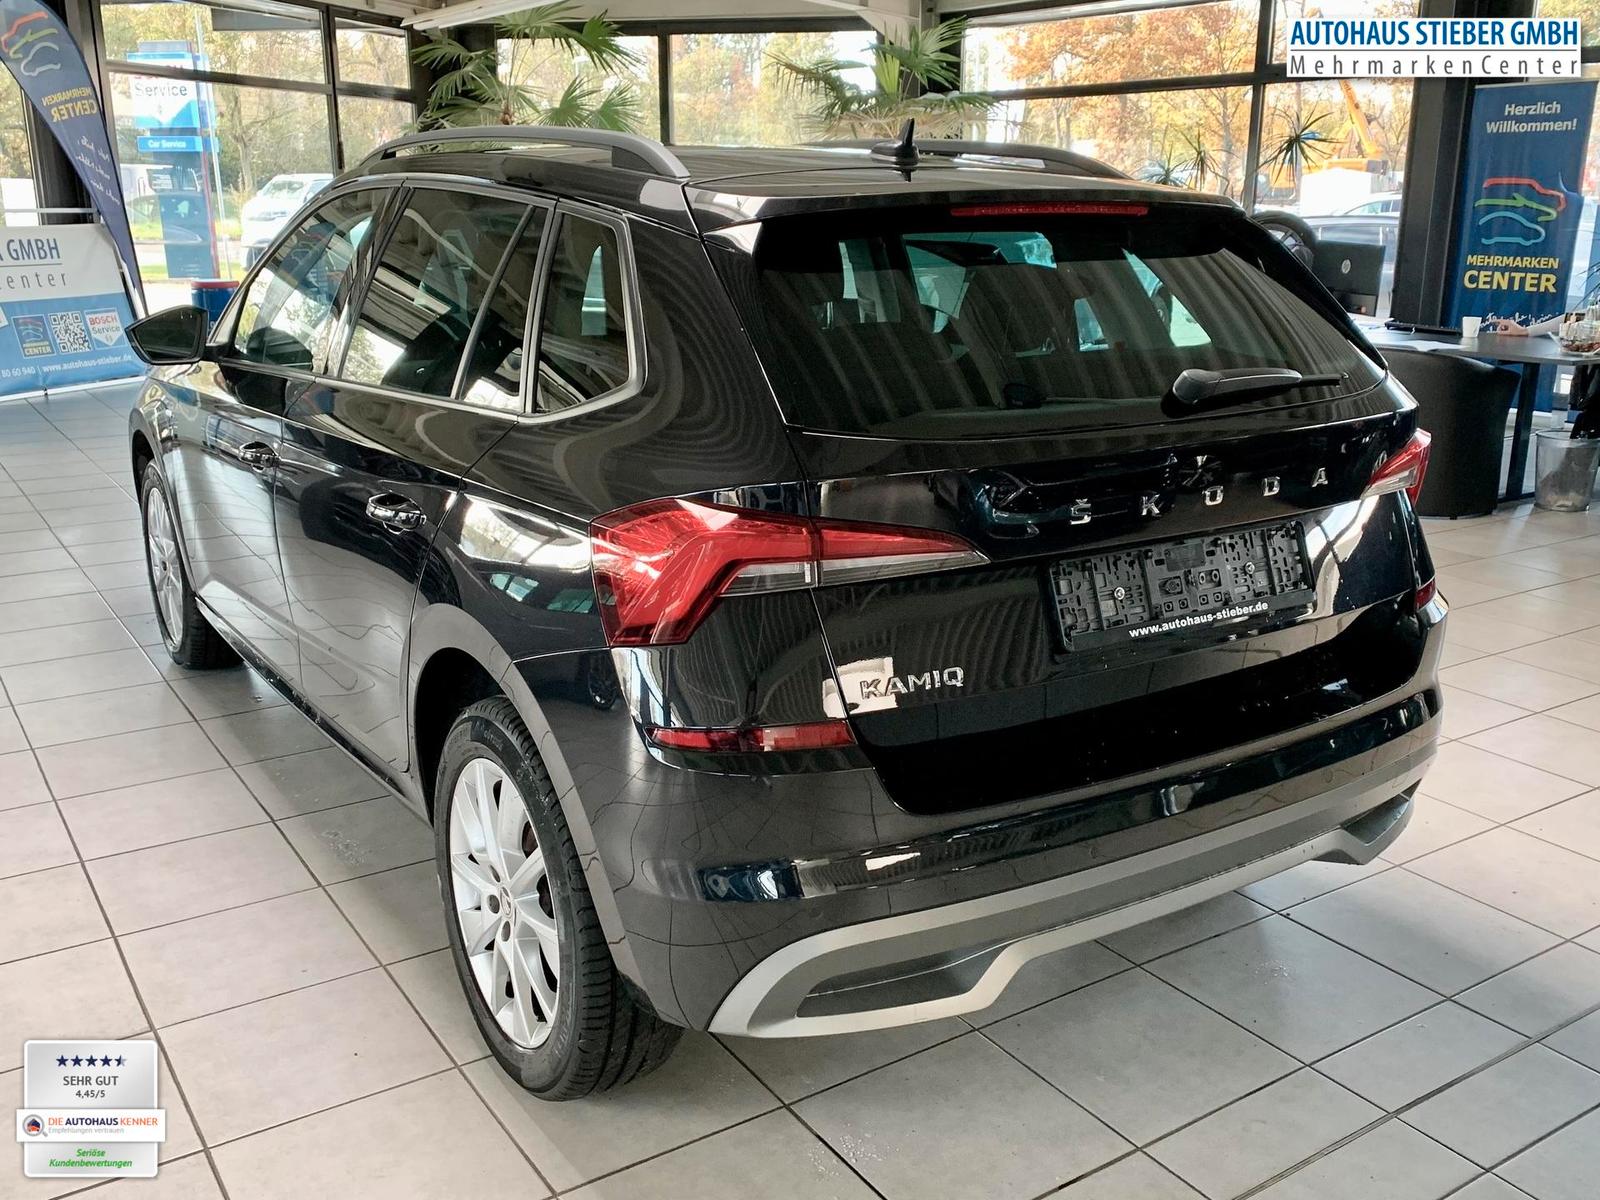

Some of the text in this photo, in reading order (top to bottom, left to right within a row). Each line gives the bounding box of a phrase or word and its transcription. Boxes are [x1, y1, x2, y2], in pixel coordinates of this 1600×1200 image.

[135, 82, 188, 97] Service
[1504, 101, 1561, 116] Herzlich
[1486, 118, 1578, 134] Willkommen!
[7, 238, 61, 261] GMBH
[1466, 254, 1560, 269] MEHRMARKEN
[1463, 270, 1557, 293] CENTER
[88, 315, 117, 326] BOSCH
[92, 324, 121, 335] Service
[1129, 600, 1269, 638] www.autohaus-stieber.de
[859, 666, 965, 700] KAMIQ
